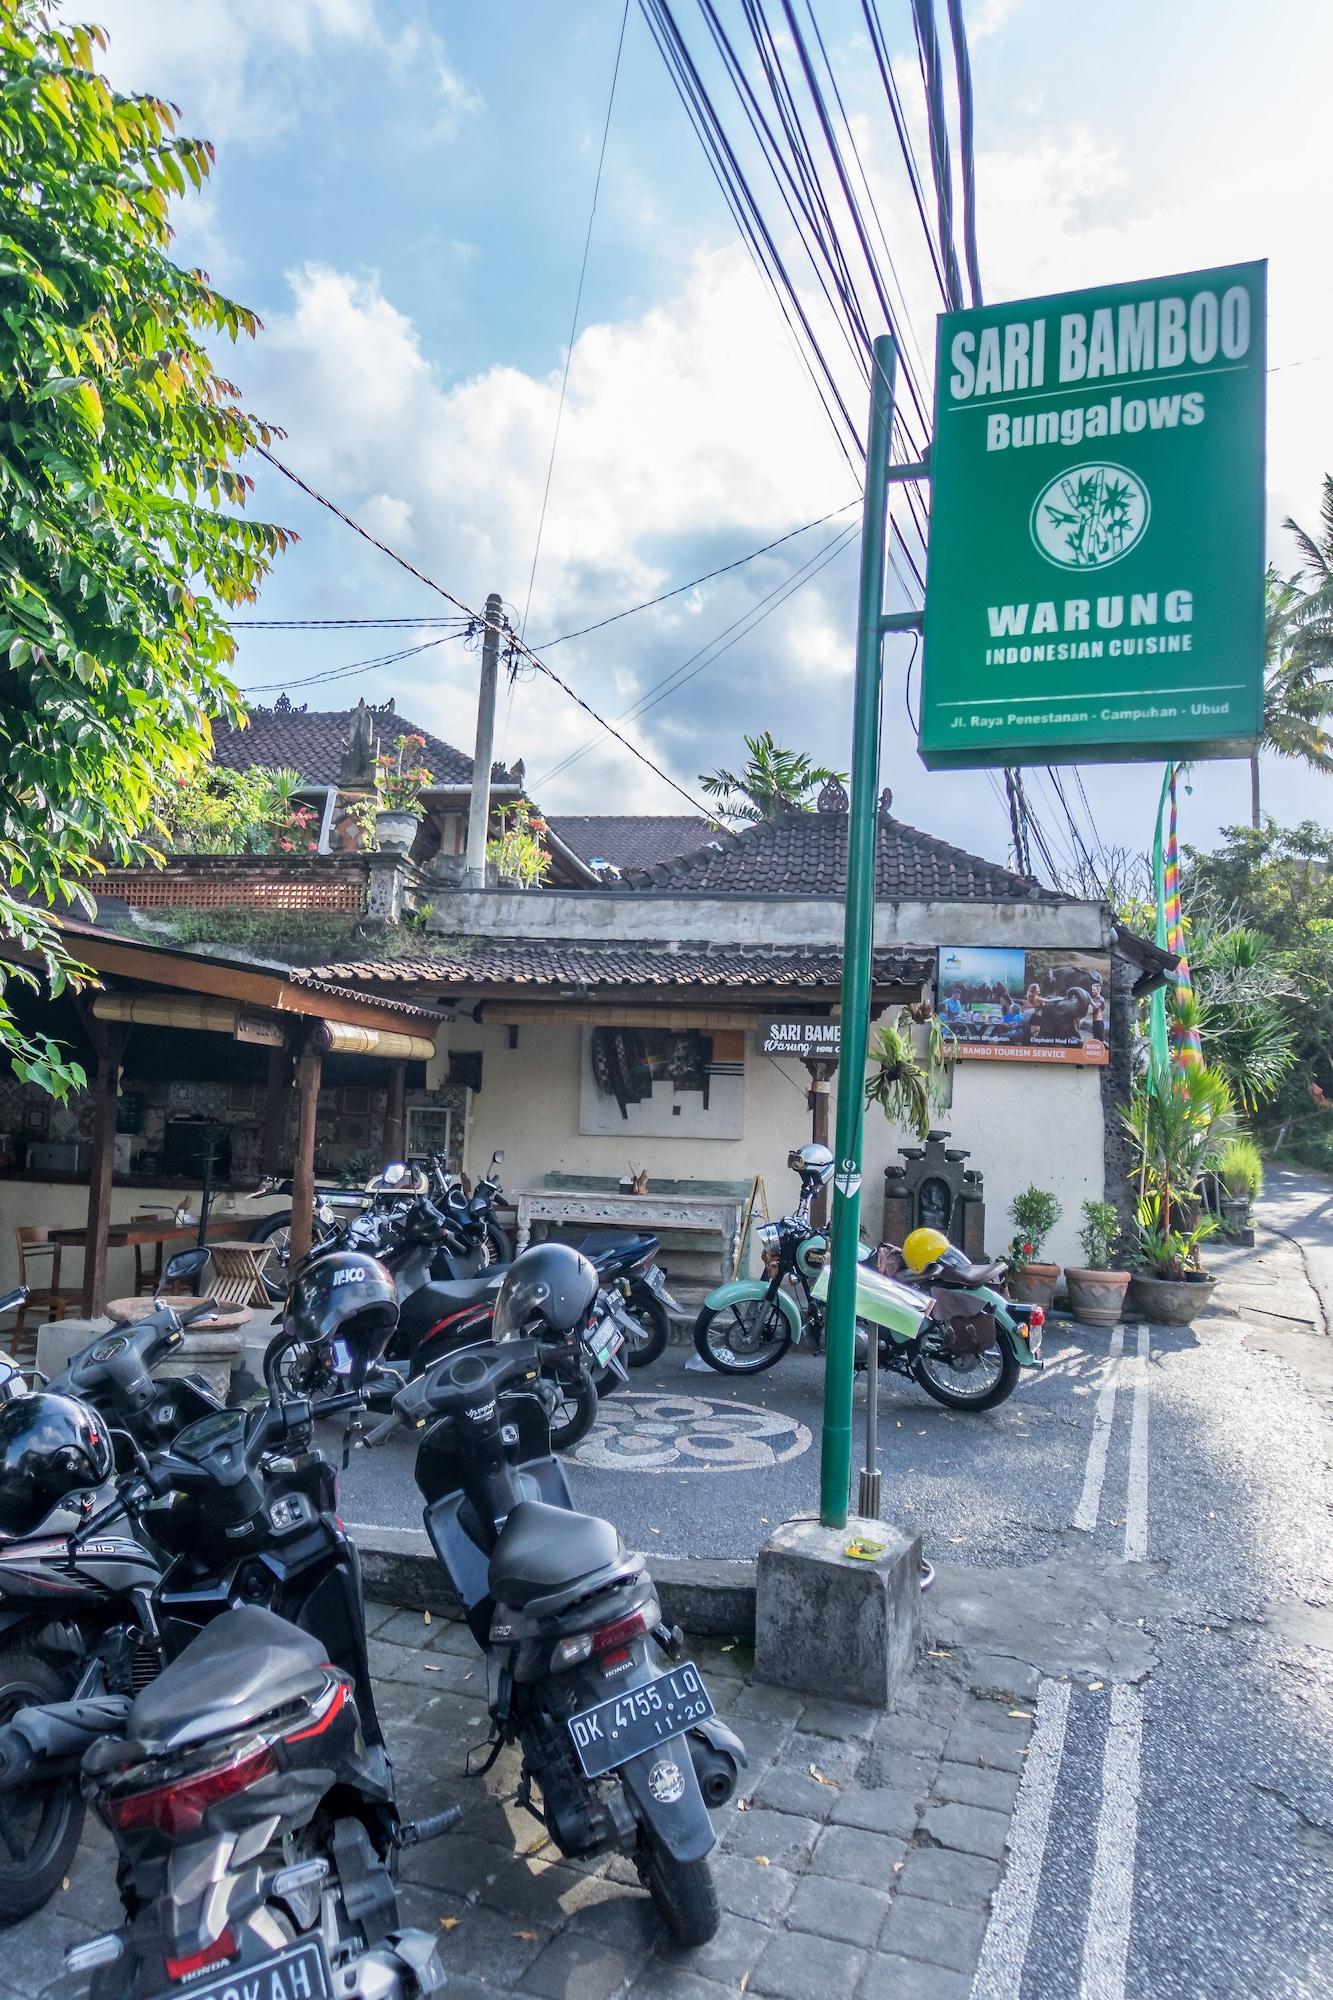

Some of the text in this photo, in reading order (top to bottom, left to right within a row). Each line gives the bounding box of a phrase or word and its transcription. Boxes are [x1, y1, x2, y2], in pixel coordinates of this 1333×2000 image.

[949, 286, 1251, 401] SARI BAMBOO
[986, 392, 1205, 452] Bungalows
[987, 590, 1194, 638] WARUNG
[985, 634, 1193, 666] INDONESIAN CUISINE
[950, 716, 967, 729] Jl.
[970, 714, 1004, 730] Raya
[1007, 711, 1089, 726] Penestanan
[1100, 705, 1177, 723] Campuhan
[1190, 703, 1230, 717] Ubud
[770, 1024, 801, 1041] SARI
[1030, 1036, 1054, 1044] Elephant
[763, 1040, 813, 1057] Warung
[963, 1047, 992, 1056] BAMBO
[993, 1048, 1031, 1057] TOURISM
[1032, 1049, 1066, 1059] SERVICE
[604, 1660, 634, 1679] HONDA
[574, 1713, 605, 1748] DK
[614, 1685, 663, 1728] 4755
[181, 1957, 231, 1984] HONDA
